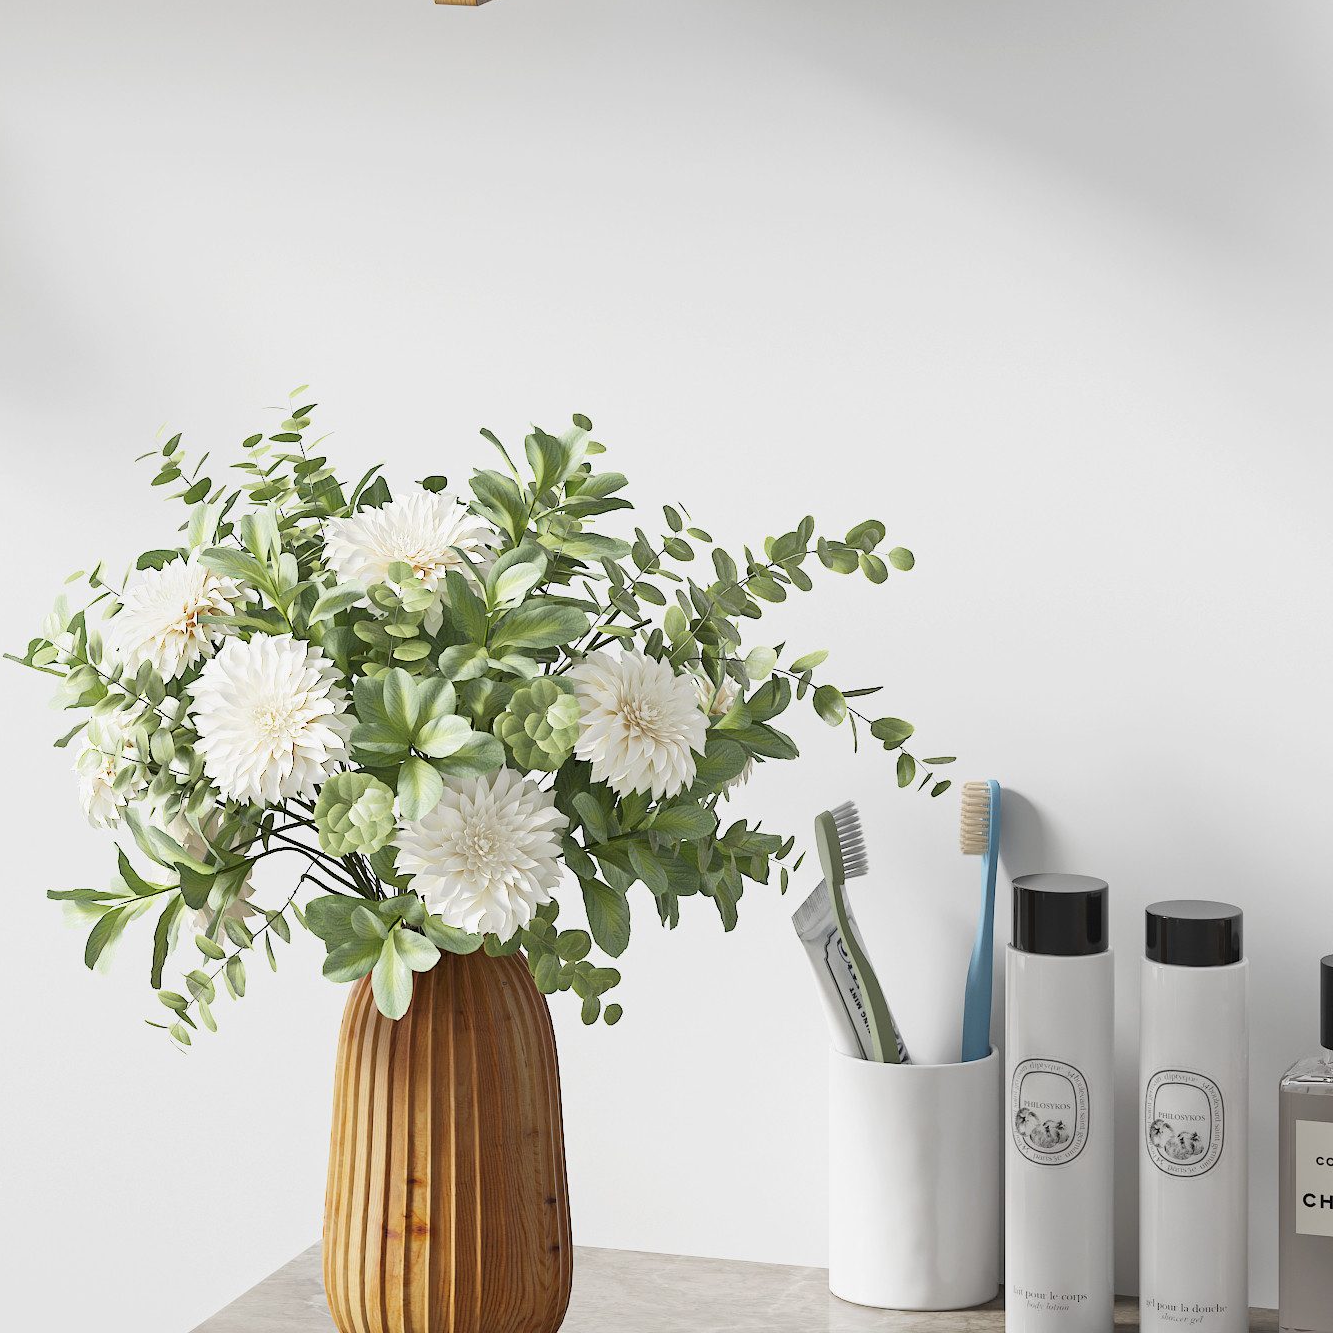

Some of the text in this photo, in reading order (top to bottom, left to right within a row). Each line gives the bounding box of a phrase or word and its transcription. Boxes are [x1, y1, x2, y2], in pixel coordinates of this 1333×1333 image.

[849, 987, 863, 1010] MINT
[1024, 1100, 1071, 1111] PHILOSYKOS
[1158, 1111, 1206, 1122] PHILOSYKOS
[1302, 1193, 1333, 1210] CH
[1025, 1289, 1046, 1300] pour
[1049, 1290, 1060, 1301] le
[1061, 1293, 1088, 1303] corps
[1026, 1299, 1070, 1312] body lotion
[1145, 1298, 1228, 1314] gel pour la douche
[1190, 1314, 1204, 1325] gel
